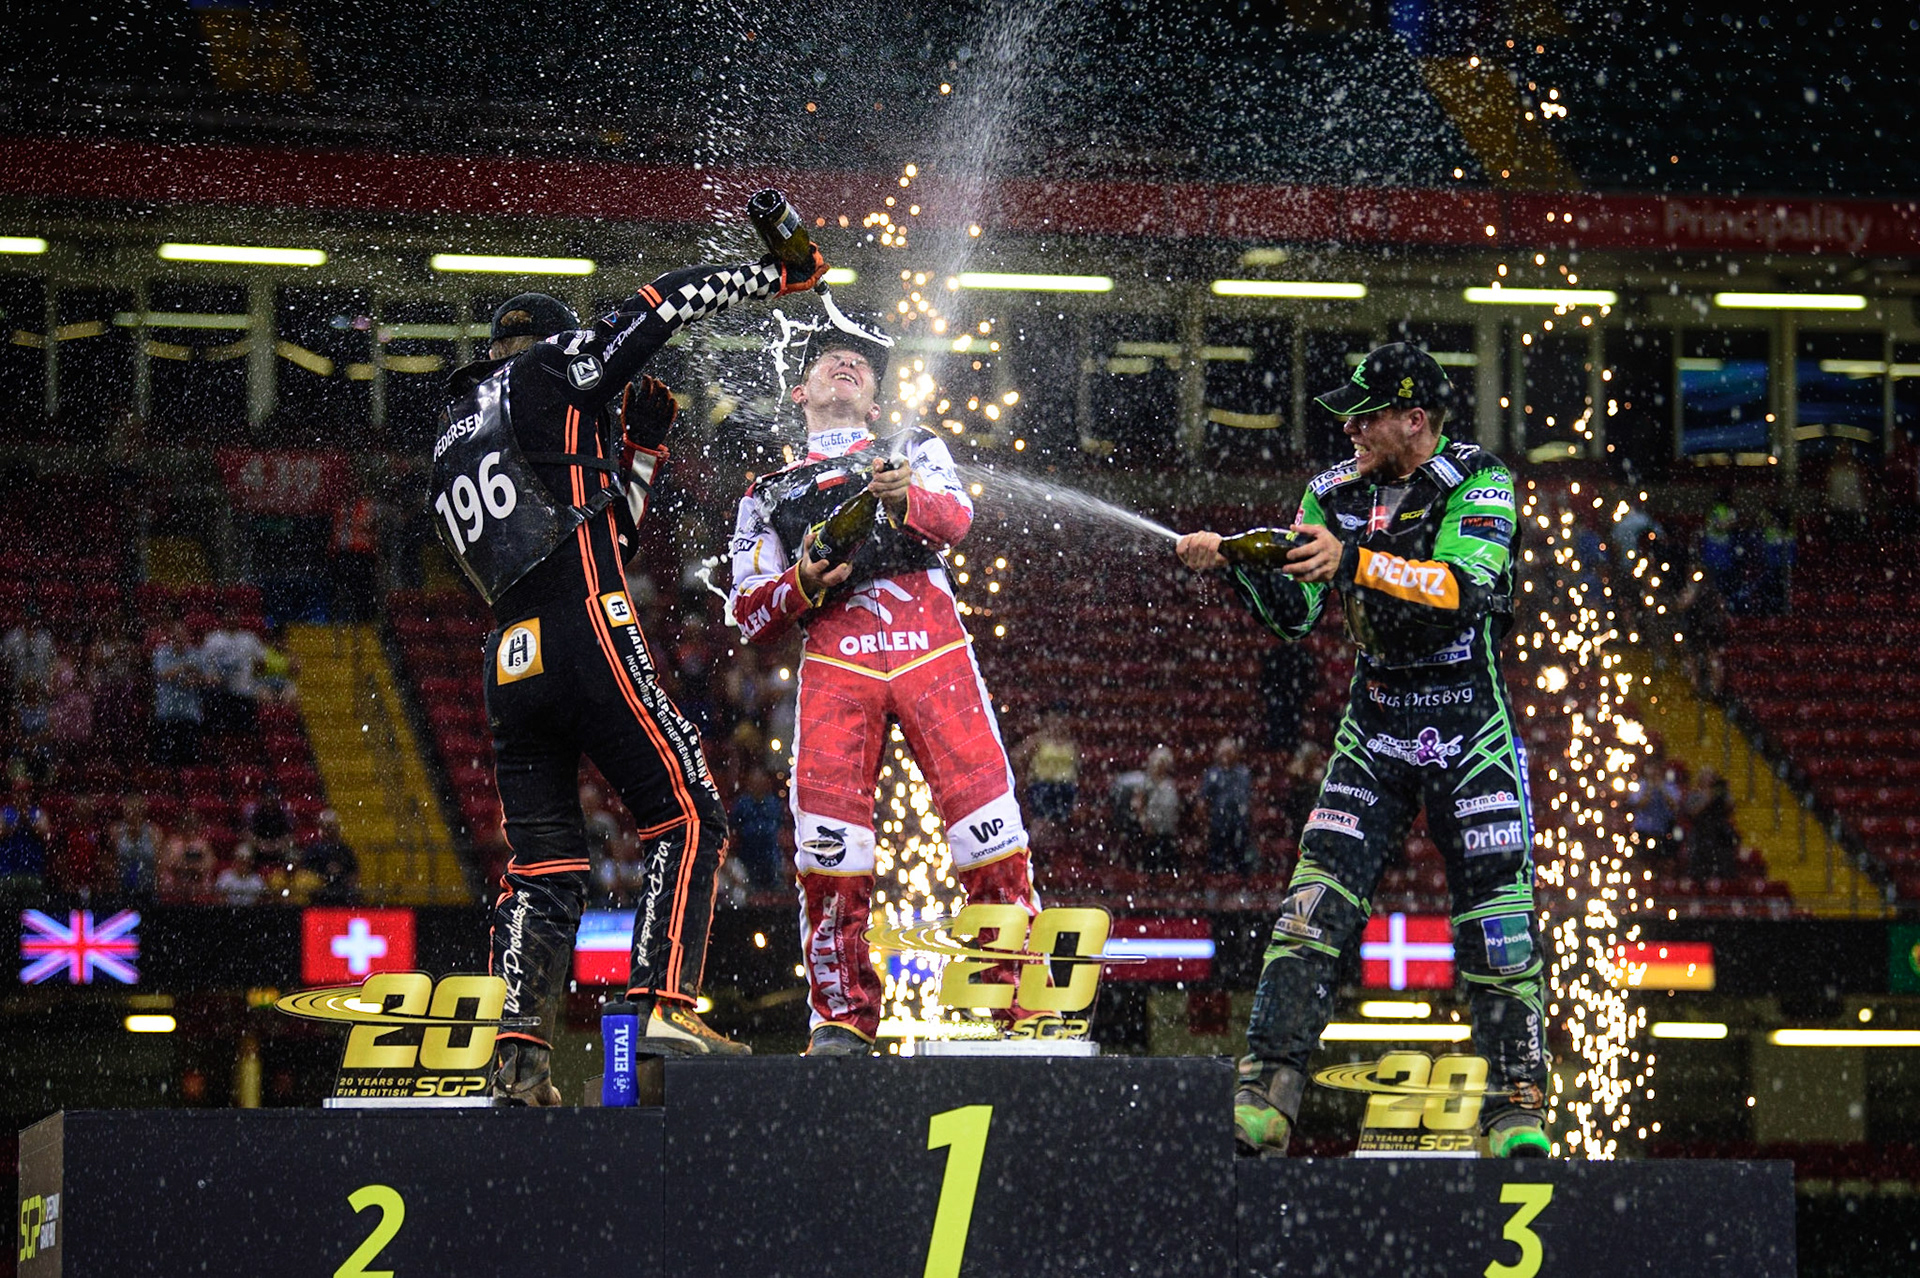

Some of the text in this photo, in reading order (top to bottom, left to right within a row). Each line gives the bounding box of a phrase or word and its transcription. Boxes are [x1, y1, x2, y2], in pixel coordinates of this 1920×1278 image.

[1665, 202, 1872, 252] Principality
[433, 410, 484, 462] PEDERSEN
[435, 451, 517, 555] 196
[839, 631, 929, 656] ORLEN
[626, 625, 653, 671] HARRY
[689, 734, 698, 746] &
[1442, 687, 1473, 703] Byg
[1325, 780, 1379, 806] bakertilly
[1457, 793, 1514, 809] TermoGo
[969, 818, 1004, 844] WP
[1465, 821, 1522, 850] Orloff
[819, 857, 838, 866] PZM
[937, 904, 1111, 1012] 20
[342, 973, 508, 1070] 20
[994, 1020, 1009, 1028] OF
[1011, 1019, 1089, 1040] SGP
[614, 1024, 630, 1073] ELTAL
[336, 1076, 487, 1097] FIM BRITISH SGP
[339, 1077, 413, 1086] 20 YEARS OF
[1365, 1053, 1490, 1130] 20
[1376, 1134, 1404, 1142] YEARS
[1418, 1135, 1474, 1151] SGP
[924, 1104, 993, 1278] 1
[333, 1184, 406, 1278] 2
[1483, 1183, 1553, 1278] 3
